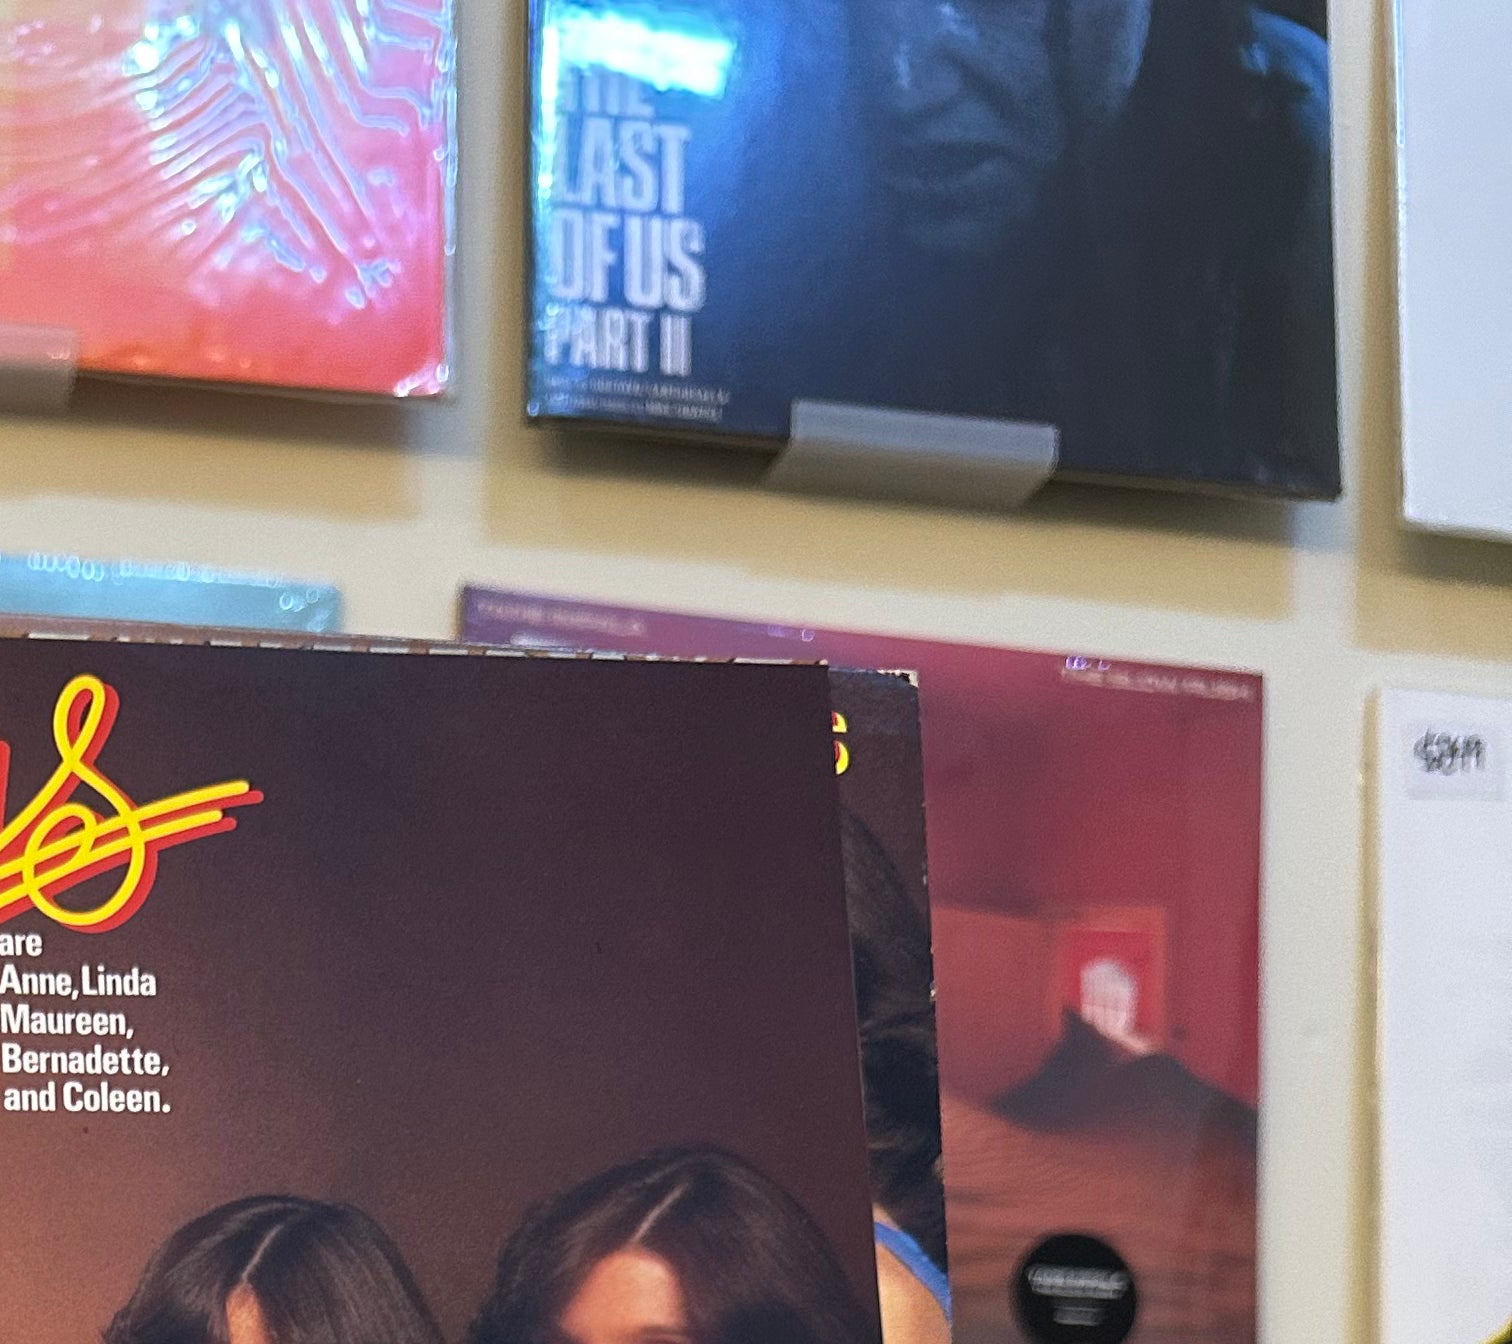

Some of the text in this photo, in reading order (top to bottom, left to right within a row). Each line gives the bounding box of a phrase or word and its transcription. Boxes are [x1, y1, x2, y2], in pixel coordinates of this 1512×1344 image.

[556, 115, 692, 216] LAST
[548, 205, 707, 314] OF US
[543, 303, 693, 380] PART II
[81, 963, 157, 997] Linda
[0, 1003, 135, 1040] Maureen,
[1, 1042, 170, 1077] Bernadette,
[3, 1080, 171, 1114] and Coleen.
